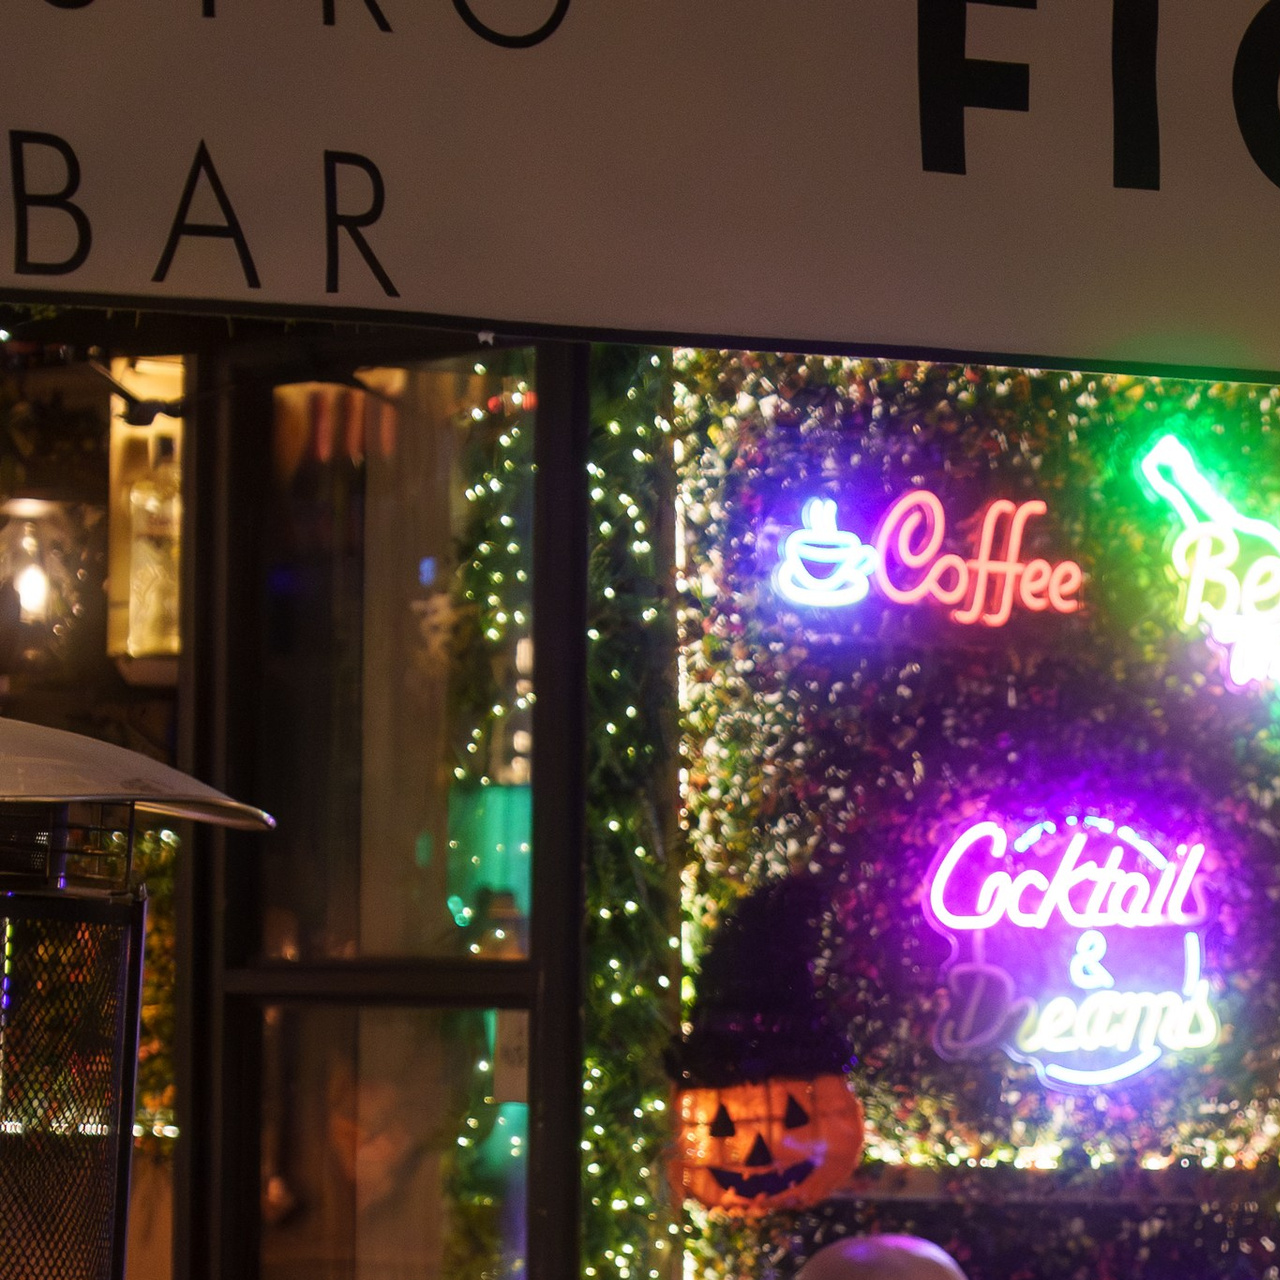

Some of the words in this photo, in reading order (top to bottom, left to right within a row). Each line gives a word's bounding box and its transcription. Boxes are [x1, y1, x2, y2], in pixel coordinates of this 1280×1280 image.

[8, 129, 400, 298] BAR
[876, 489, 1083, 627] Coffee
[930, 821, 1205, 929] Cocktail
[1070, 929, 1115, 989] &
